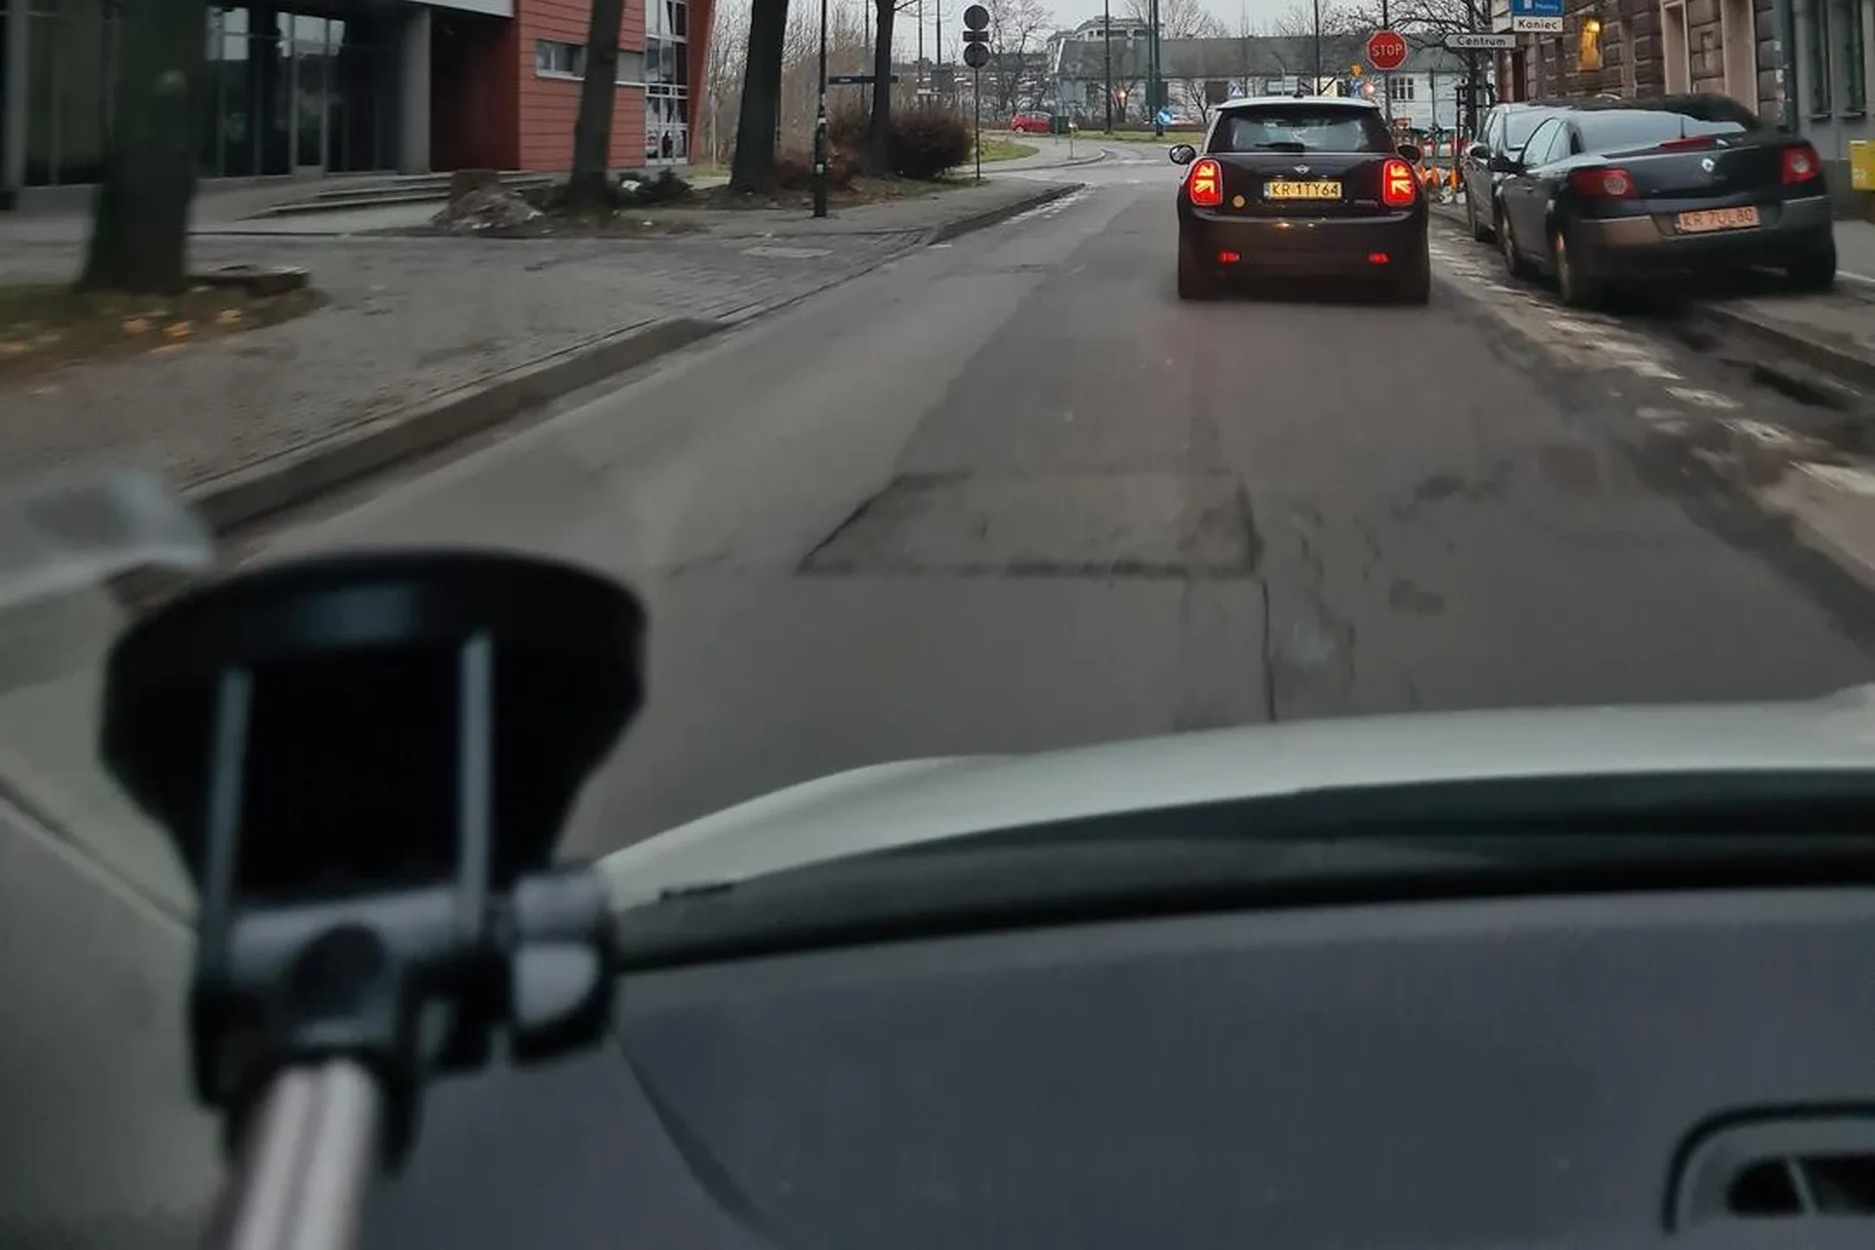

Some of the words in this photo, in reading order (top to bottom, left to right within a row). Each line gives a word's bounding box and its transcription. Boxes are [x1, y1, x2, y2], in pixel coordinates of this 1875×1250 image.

[1518, 19, 1557, 29] Koniec
[1457, 36, 1507, 46] Centrum
[1372, 43, 1403, 56] STOP
[1272, 183, 1290, 196] KR
[1295, 183, 1339, 196] 1TY64
